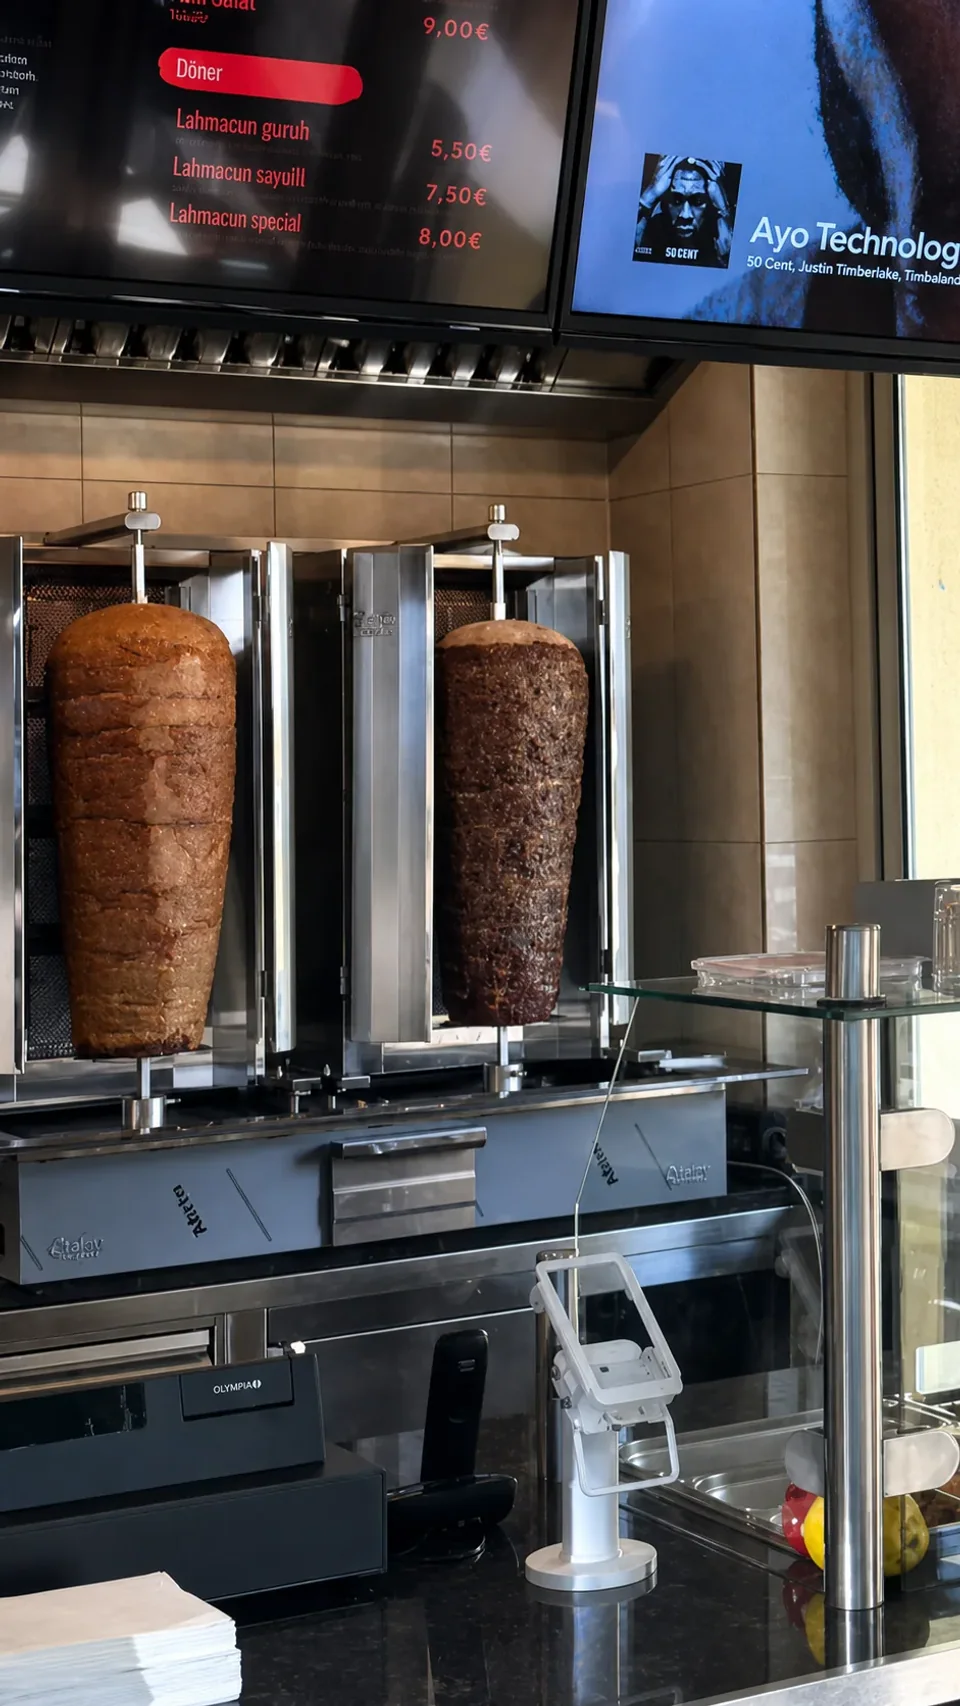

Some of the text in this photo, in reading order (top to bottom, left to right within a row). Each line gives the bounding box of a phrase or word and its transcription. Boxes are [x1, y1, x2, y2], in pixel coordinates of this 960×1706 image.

[423, 17, 490, 41] 9,00€
[176, 57, 223, 82] Döner
[176, 108, 257, 136] Lahmacun
[431, 139, 493, 163] 5,50€
[172, 156, 252, 183] Lahmacun
[426, 184, 487, 206] 7,50€
[169, 202, 302, 234] Lahmacun special
[418, 228, 482, 250] 8,00€
[750, 216, 960, 270] Ayo Technolog
[677, 247, 699, 260] CENT
[747, 255, 763, 268] 50
[765, 257, 796, 274] Cent,
[798, 261, 834, 275] Justin
[836, 263, 902, 282] Timberlake,
[213, 1381, 253, 1394] OLYMPIA
